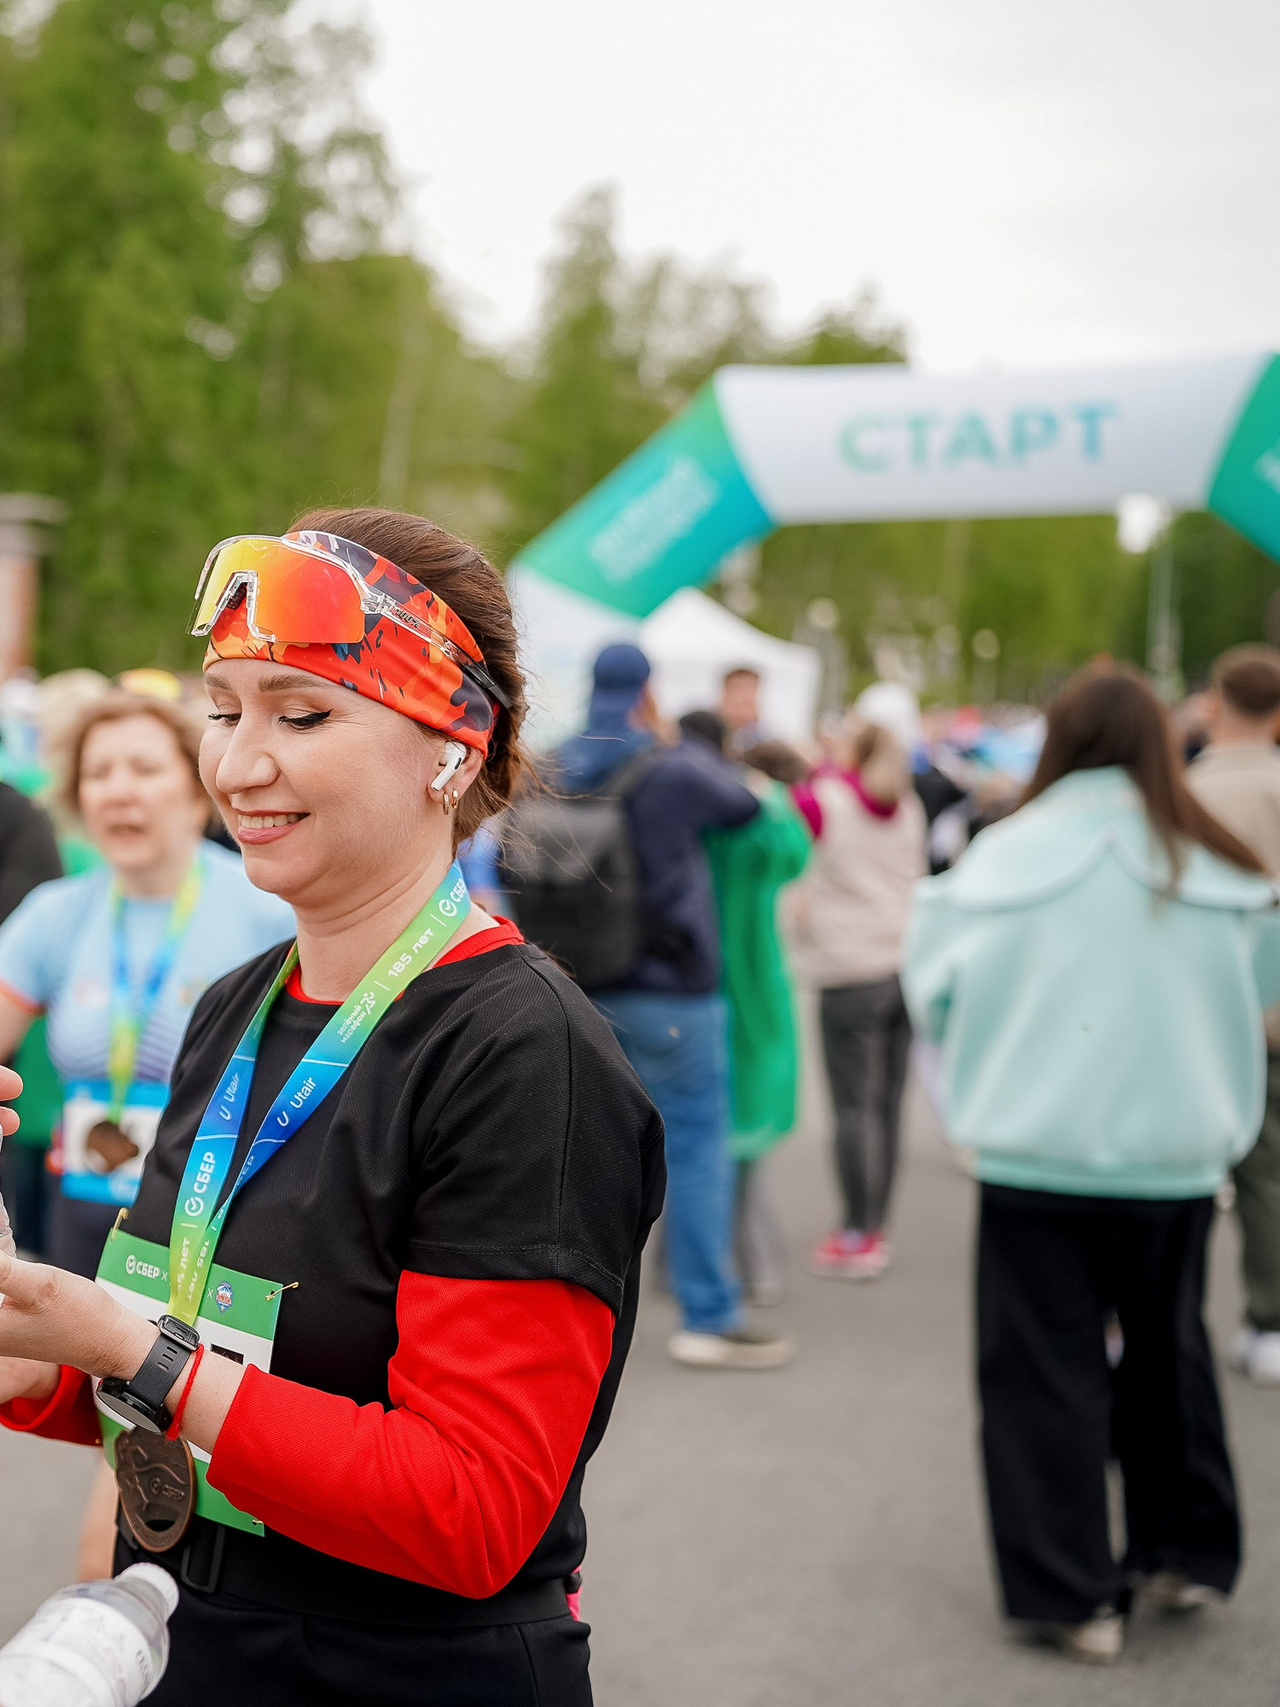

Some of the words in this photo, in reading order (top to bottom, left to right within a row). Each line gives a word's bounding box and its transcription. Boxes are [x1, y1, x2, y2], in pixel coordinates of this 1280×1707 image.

[834, 402, 1120, 473] СТАРТ
[387, 952, 413, 977] 185
[412, 927, 435, 954] лет
[340, 1011, 366, 1044] марафон
[223, 1072, 239, 1103] Utair
[289, 1077, 317, 1109] Utair
[193, 1151, 216, 1194] СБЕР
[136, 1261, 160, 1280] СБЕР
